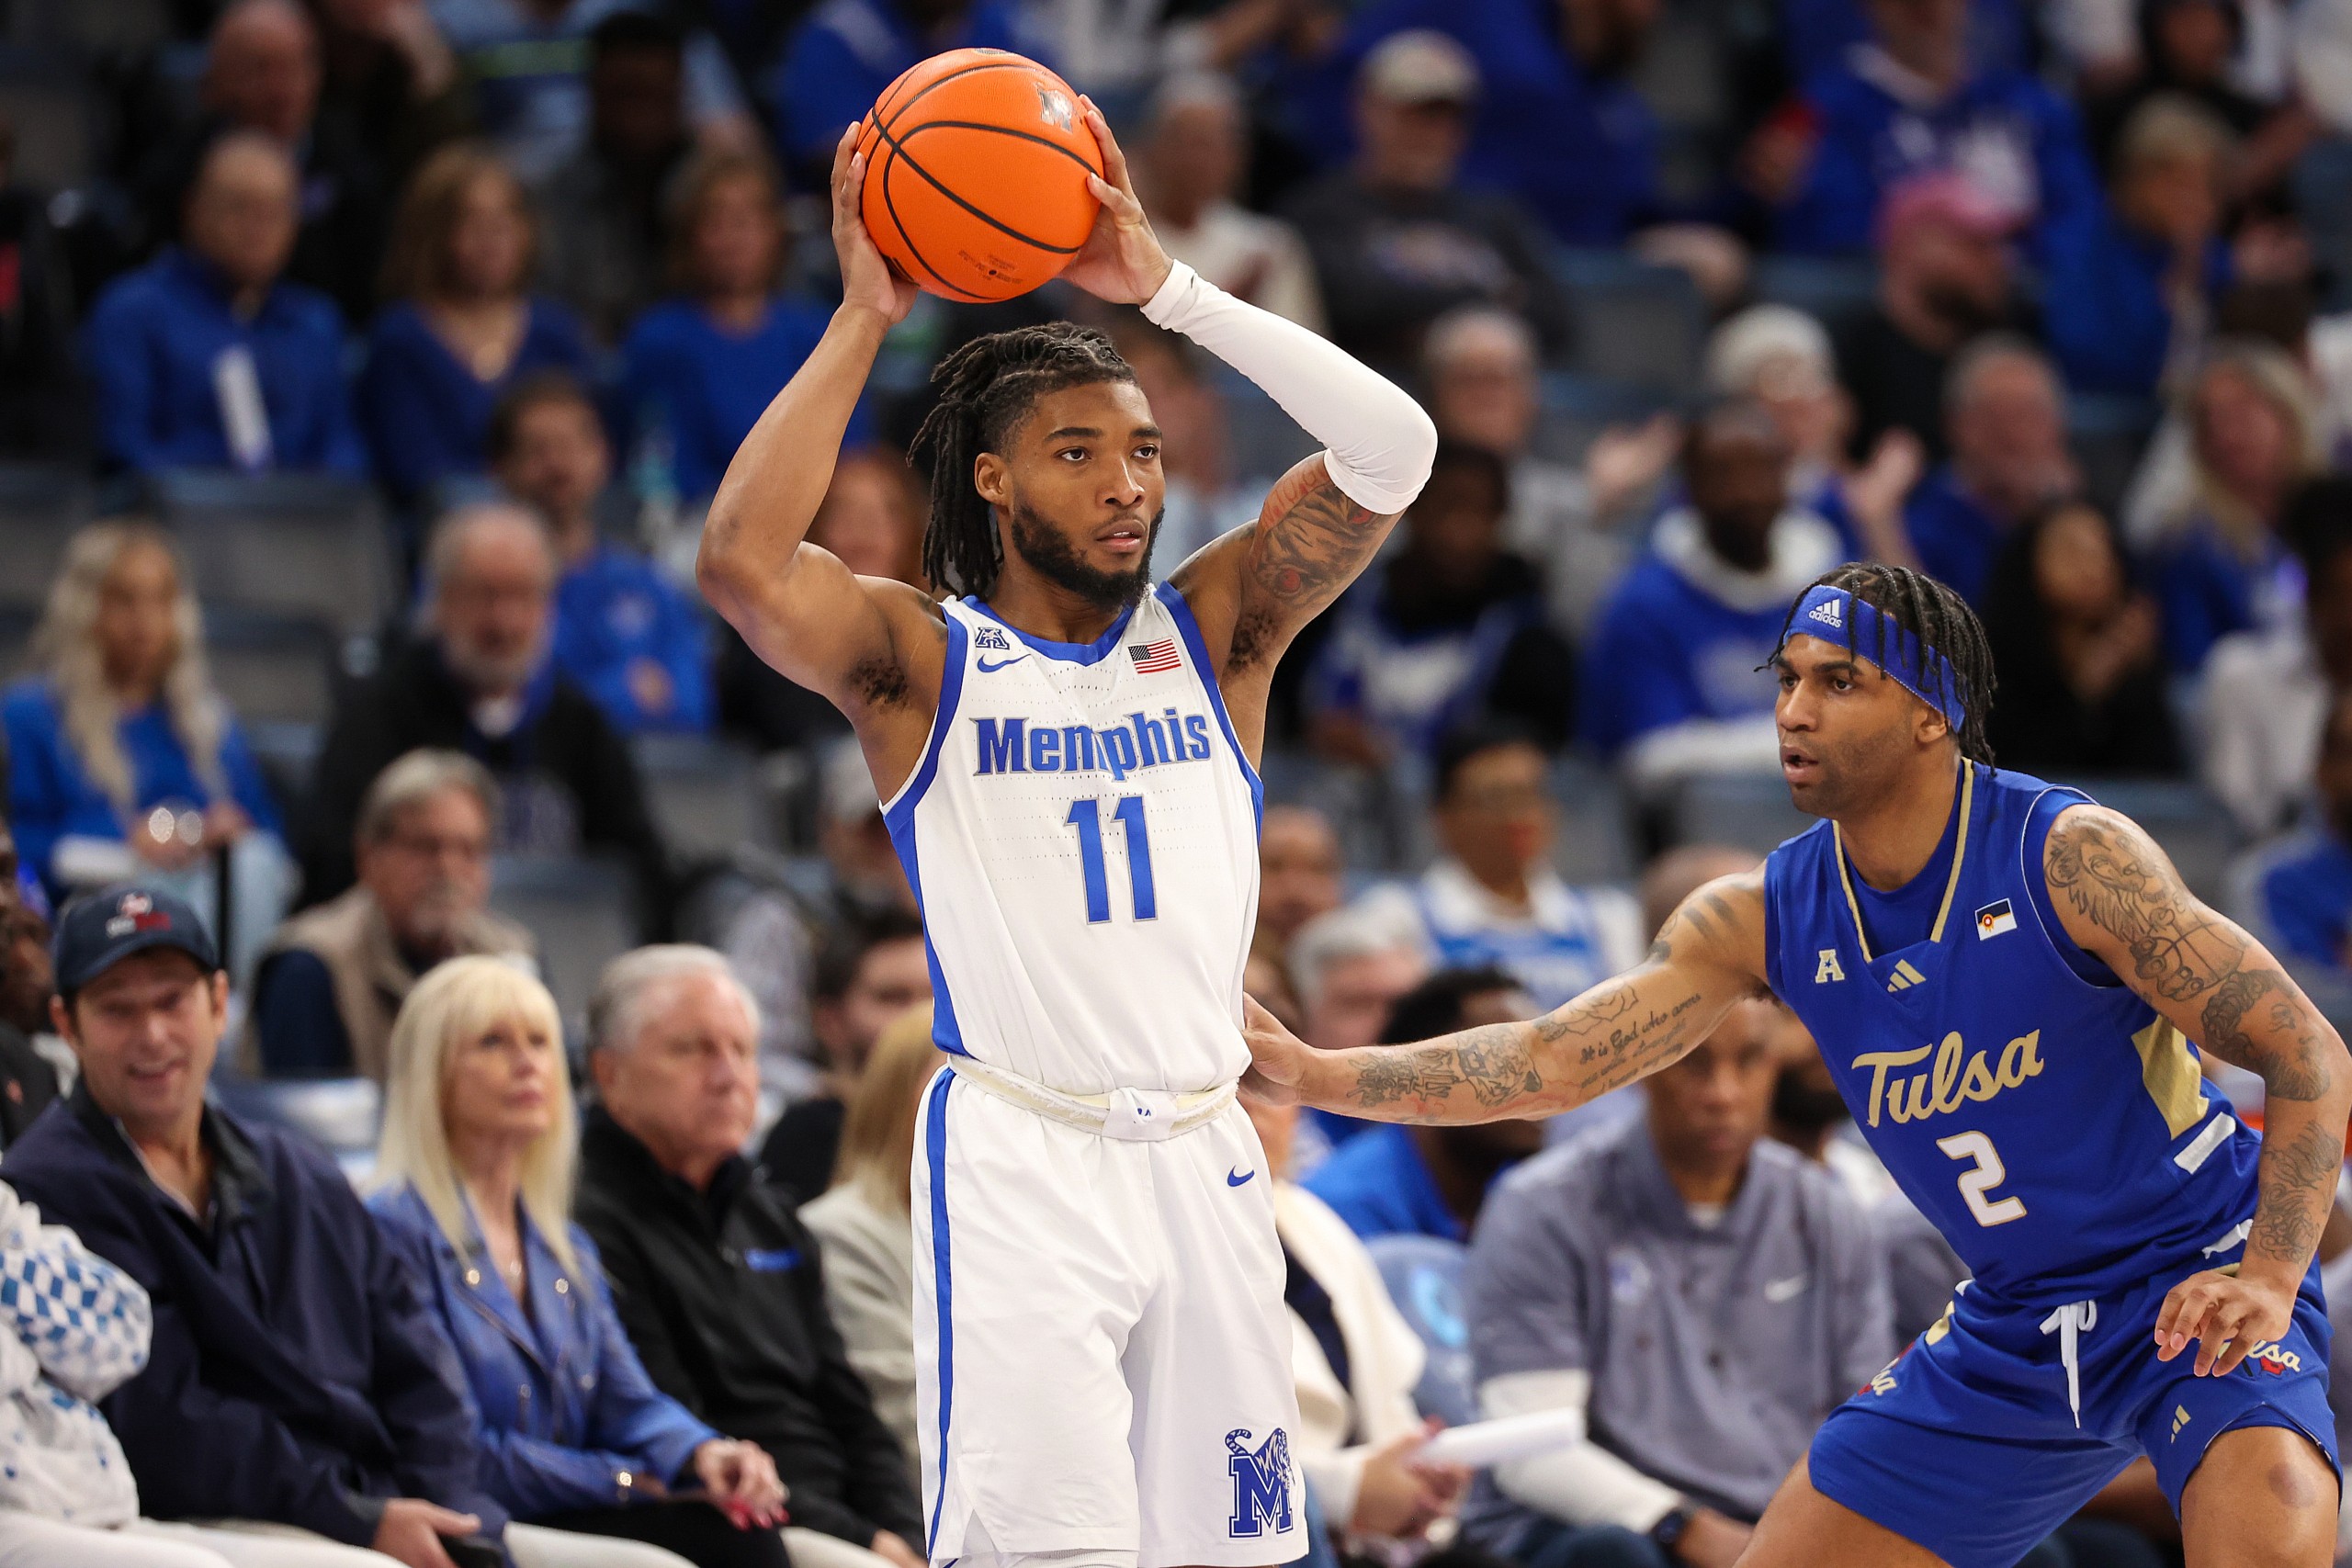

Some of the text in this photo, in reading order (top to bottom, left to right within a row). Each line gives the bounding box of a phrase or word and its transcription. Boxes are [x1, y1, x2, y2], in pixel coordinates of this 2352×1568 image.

[1809, 610, 1842, 628] adidas
[968, 706, 1212, 783] Memphis
[1063, 793, 1159, 925] 11
[1815, 949, 1845, 983] A
[1642, 1010, 1668, 1033] who
[1851, 1029, 2044, 1128] Tulsa
[1936, 1130, 2028, 1227] 2
[1228, 1453, 1294, 1538] M
